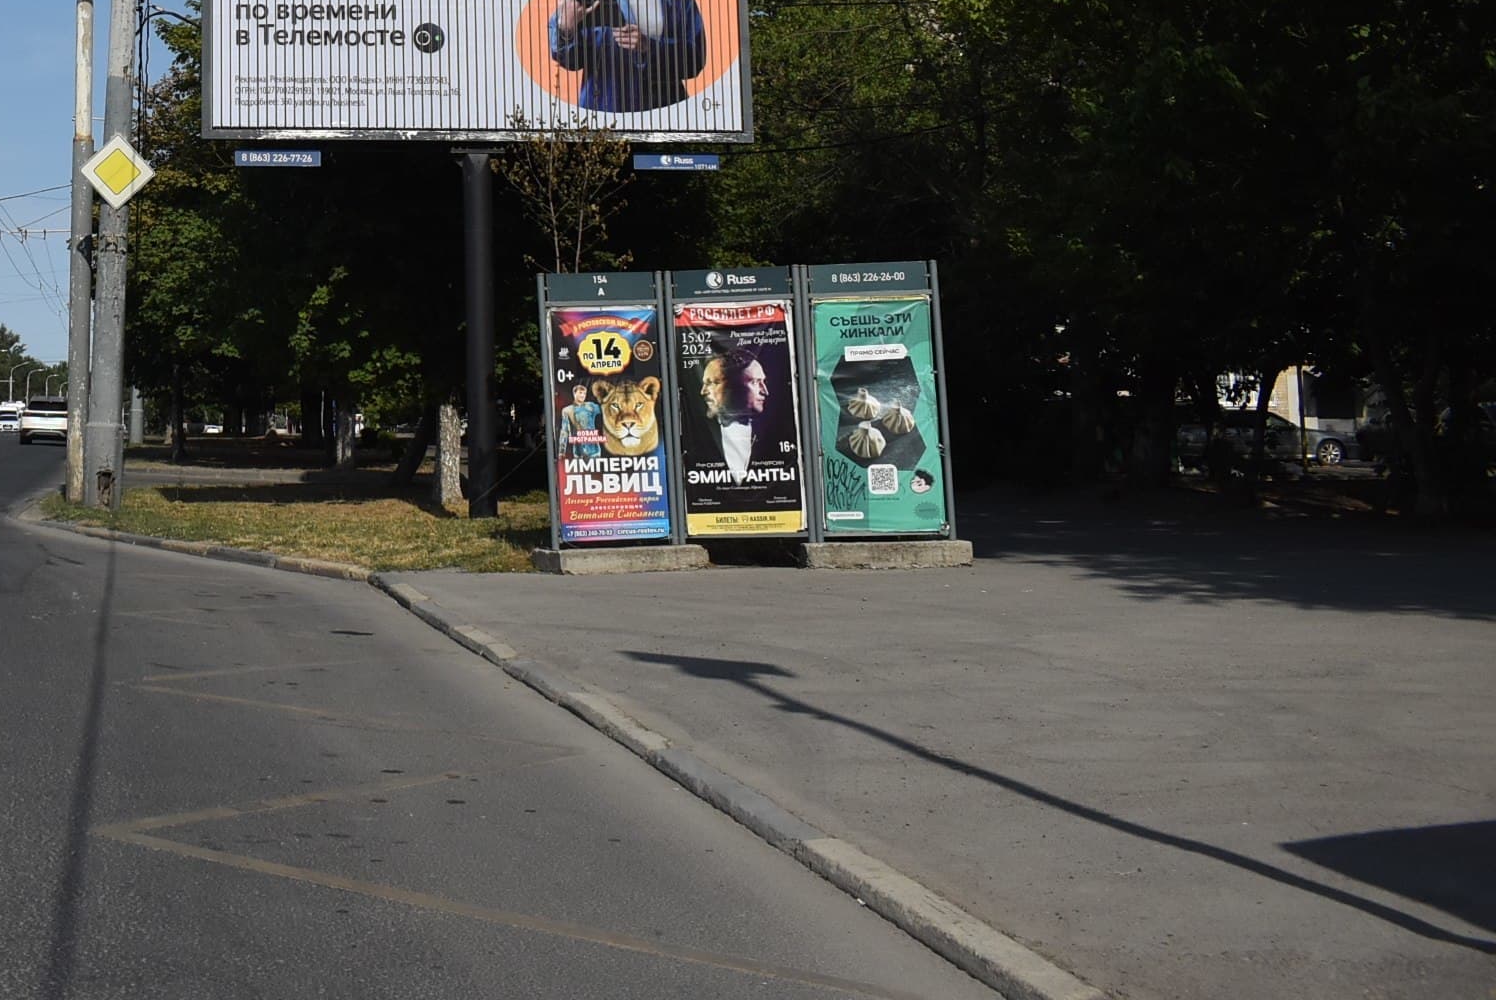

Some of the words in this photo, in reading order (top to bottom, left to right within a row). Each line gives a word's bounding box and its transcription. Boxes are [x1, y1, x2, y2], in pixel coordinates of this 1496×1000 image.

[235, 3, 270, 21] по
[277, 3, 397, 25] времени
[235, 29, 251, 47] в
[257, 23, 406, 47] Телемосте
[701, 97, 721, 112] 0+
[241, 152, 247, 162] 8
[249, 152, 271, 163] (863)
[272, 153, 313, 163] 226-77-26
[726, 274, 757, 286] Russ
[831, 273, 838, 283] 8
[839, 272, 861, 284] (863)
[862, 271, 905, 282] 226-26-00
[689, 305, 775, 321] РОСБИЛЕТ.РФ
[829, 314, 881, 327] СЪЕШЬ
[884, 312, 912, 325] ЭТИ
[681, 331, 713, 344] 15.02
[839, 326, 905, 339] ХИНКАЛИ
[591, 337, 622, 360] 14
[682, 344, 713, 355] 2024
[590, 360, 622, 369] АПРЕЛЯ
[557, 368, 575, 383] 0+
[779, 440, 797, 453] 16+
[563, 456, 659, 474] ИМПЕРИЯ
[687, 467, 796, 484] ЭМИГРАНТЫ
[563, 472, 663, 496] ЛЬВИЦ
[569, 510, 615, 521] Виталий
